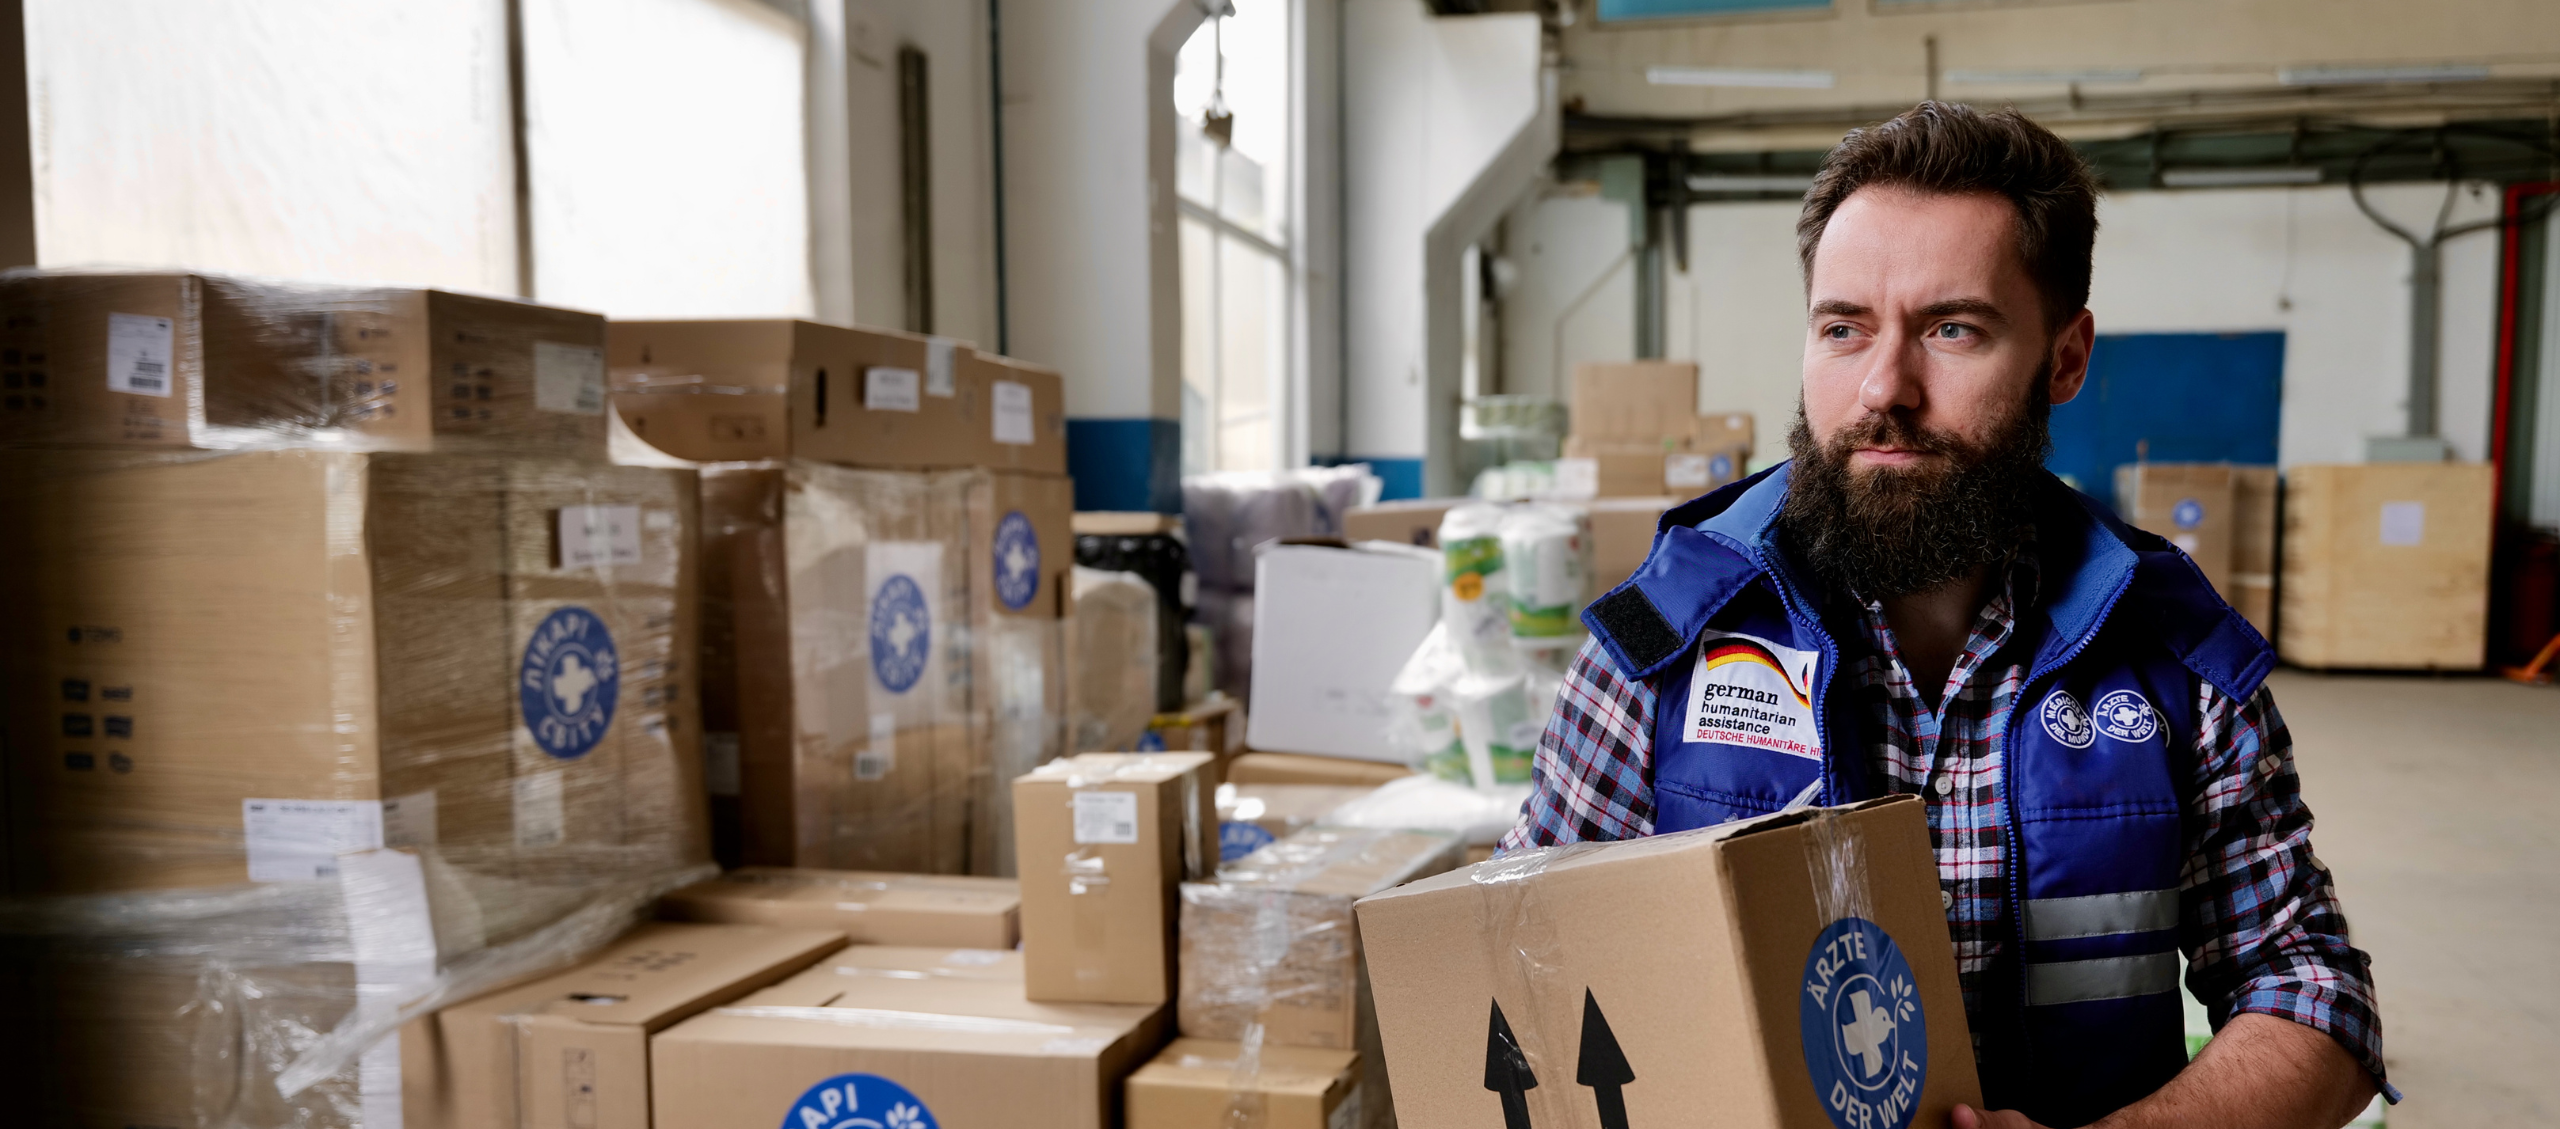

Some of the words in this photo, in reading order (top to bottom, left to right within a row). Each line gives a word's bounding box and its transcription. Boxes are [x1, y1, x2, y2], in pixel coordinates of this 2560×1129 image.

[1704, 683, 1778, 705] german
[1701, 701, 1796, 726] humanitarian
[2097, 695, 2129, 717] ÄRZTE
[538, 702, 605, 750] СВІТУ
[1699, 717, 1770, 735] assistance
[2049, 722, 2066, 740] DEL
[2068, 727, 2091, 744] MUNDO
[2106, 725, 2130, 738] DER
[2131, 719, 2153, 738] WELT
[1697, 729, 1744, 742] DEUTSCHE
[1747, 735, 1806, 753] HUMANITÄRE
[1810, 747, 1823, 757] HI
[1807, 932, 1867, 1011] ÄRZTE
[1830, 1079, 1872, 1129] DER
[1876, 1049, 1919, 1129] WELT
